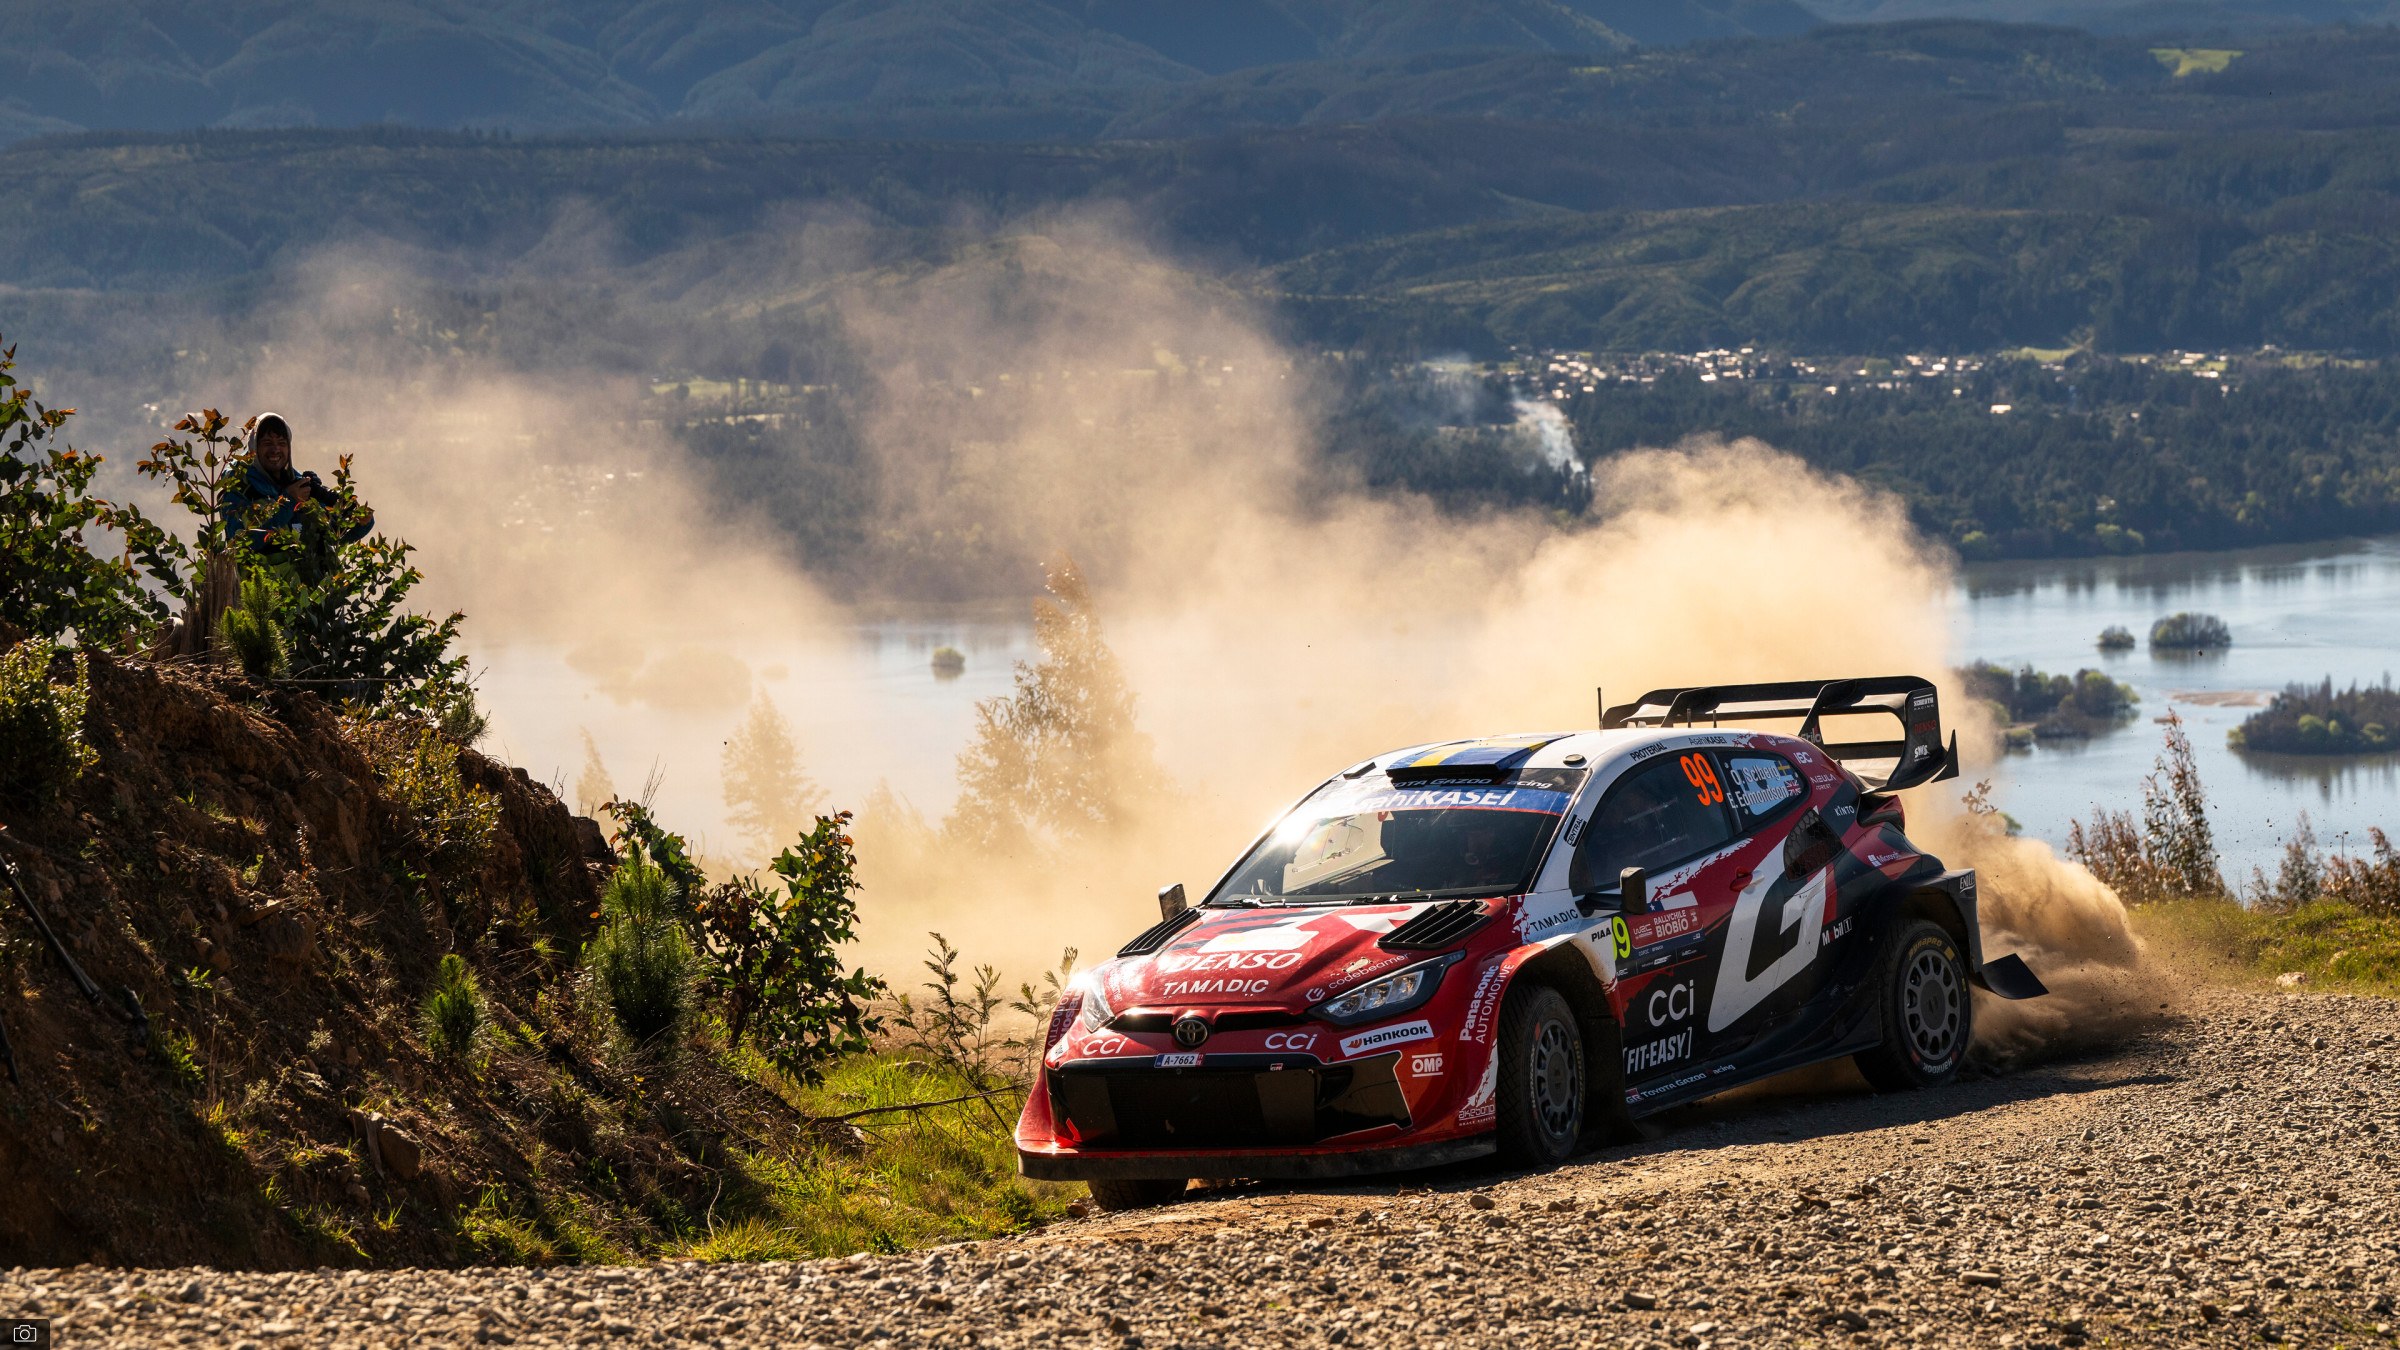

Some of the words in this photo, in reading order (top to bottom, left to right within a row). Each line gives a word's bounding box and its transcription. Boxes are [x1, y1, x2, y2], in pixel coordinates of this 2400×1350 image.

[1688, 736, 1728, 746] AsahiKASEI
[1630, 742, 1668, 762] PROTERIAL
[1680, 752, 1724, 806] 99
[1730, 769, 1745, 786] O.
[1726, 793, 1739, 809] E.
[1735, 785, 1790, 807] Edmondson
[1567, 817, 1583, 845] CENTRAL
[1530, 909, 1579, 932] TAMADIC
[1591, 927, 1612, 942] PIAA
[1166, 952, 1303, 973] DENSO
[1328, 953, 1410, 990] codebeamer
[1163, 979, 1269, 996] TAMADIC
[1459, 965, 1499, 1041] Panasonic
[1475, 963, 1515, 1044] AUTOMOTIVE
[1163, 1055, 1195, 1066] A-7662
[1412, 1055, 1443, 1075] OMP
[1641, 1083, 1677, 1098] TOYOTA
